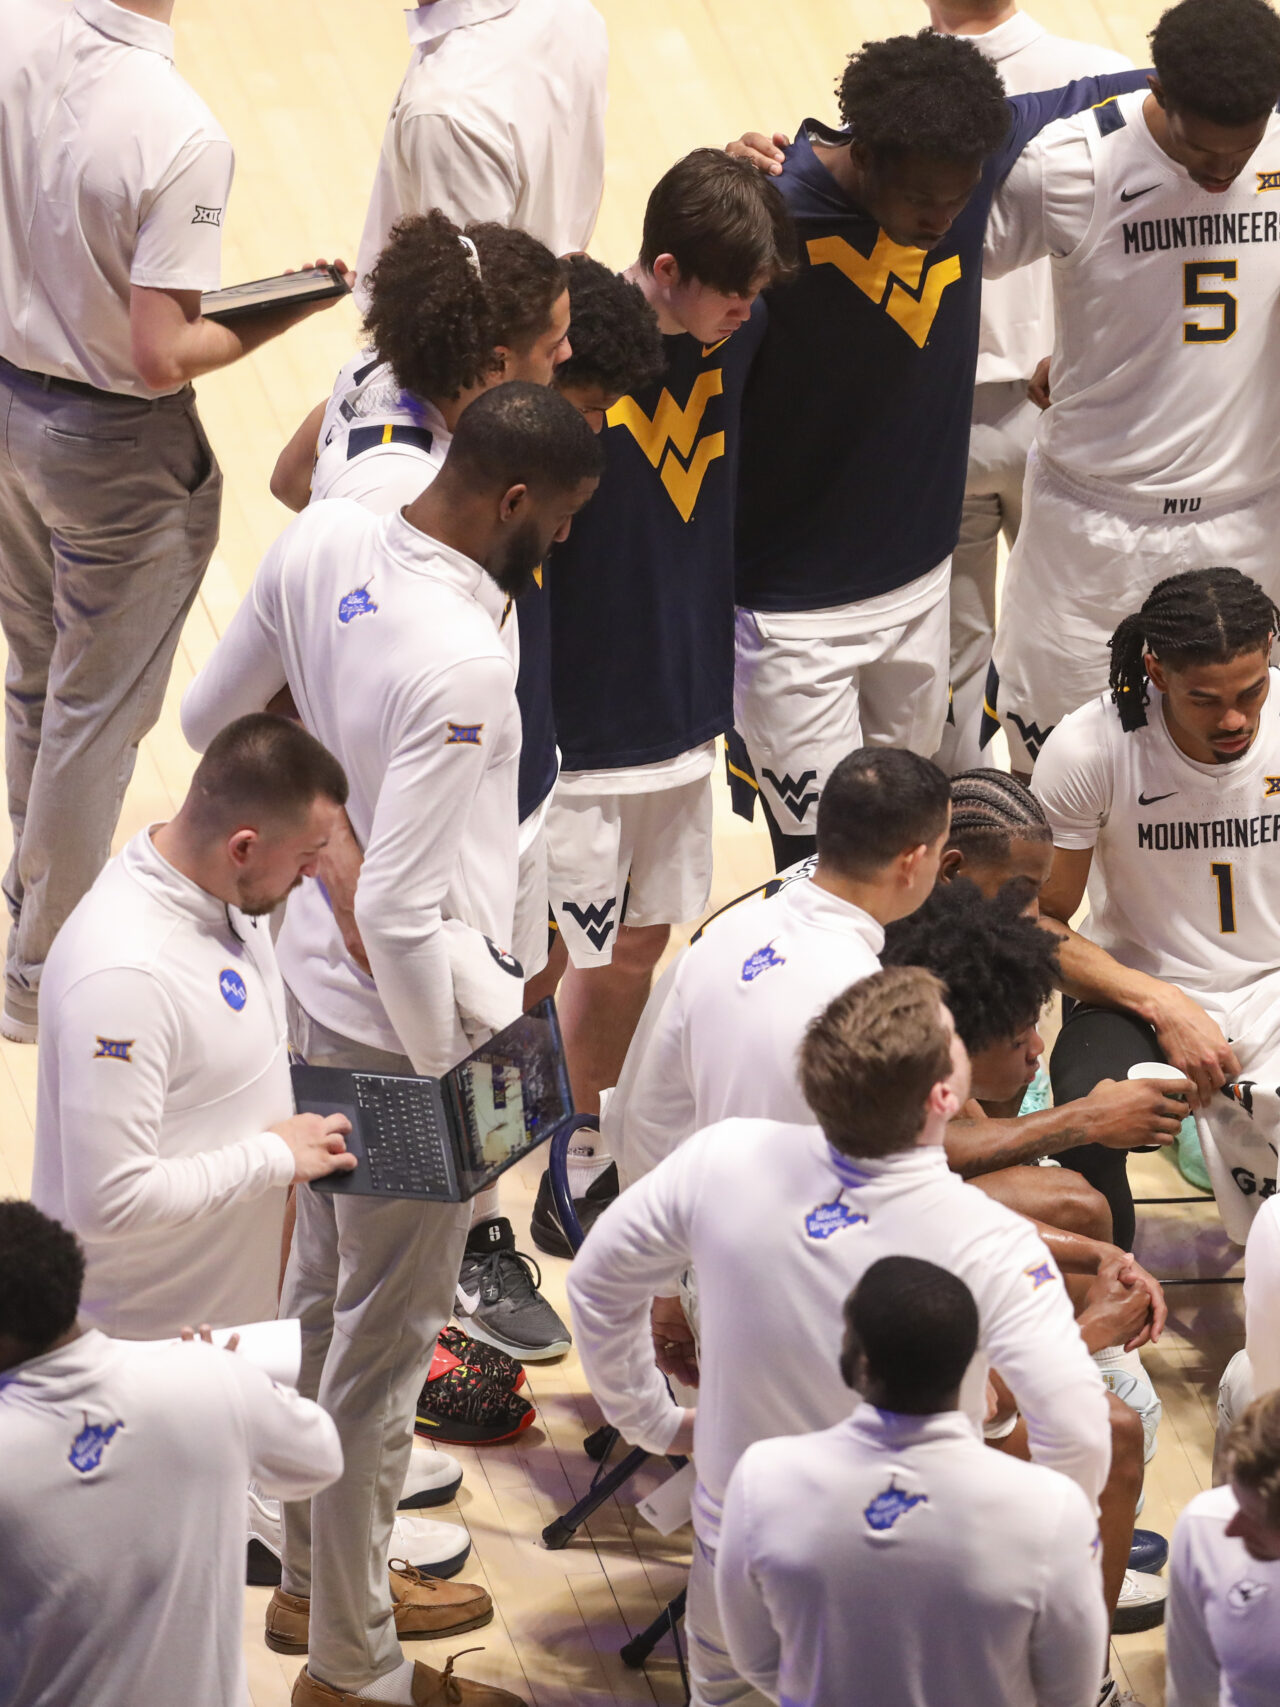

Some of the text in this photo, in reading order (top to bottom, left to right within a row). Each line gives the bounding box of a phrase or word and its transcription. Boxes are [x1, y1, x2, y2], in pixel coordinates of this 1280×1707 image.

[1183, 258, 1238, 344] 5
[1163, 497, 1201, 514] WVU
[1210, 862, 1237, 934] 1
